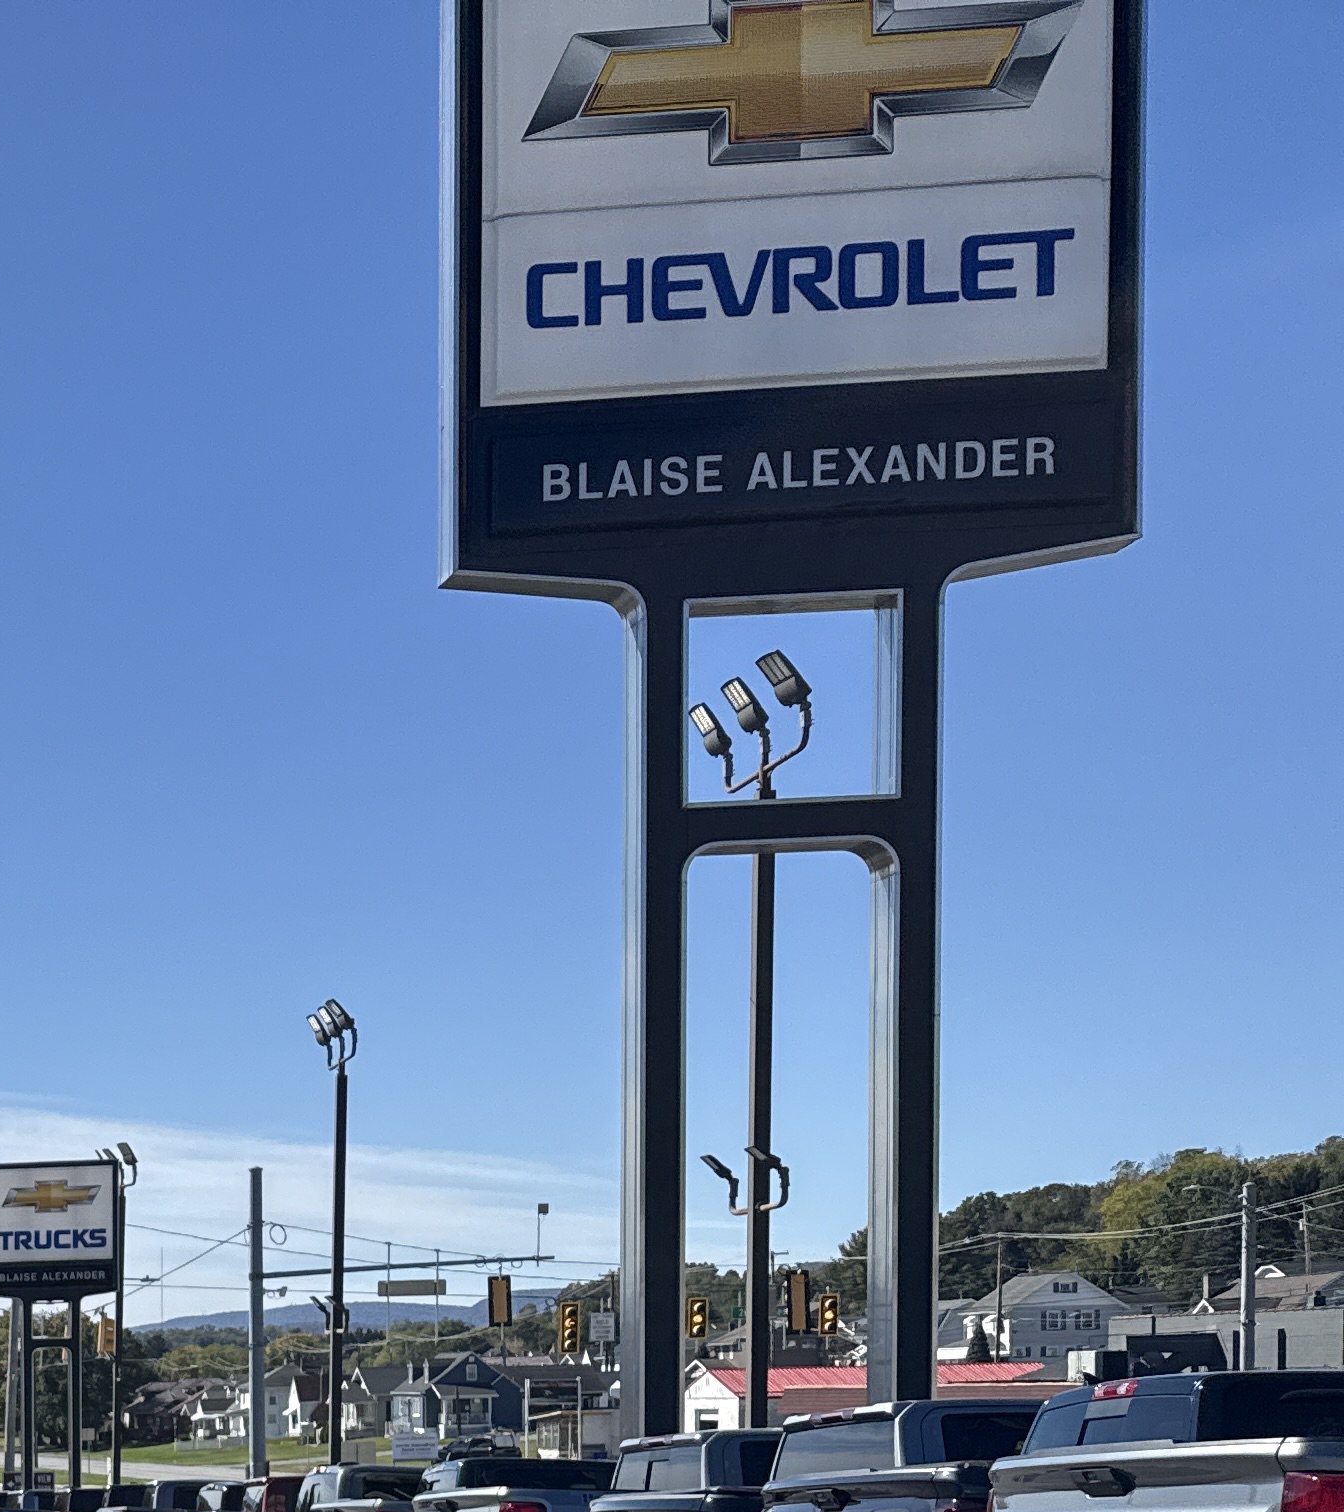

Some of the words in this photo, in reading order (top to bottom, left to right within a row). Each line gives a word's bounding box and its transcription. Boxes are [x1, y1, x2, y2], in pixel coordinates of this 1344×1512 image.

[525, 227, 1075, 330] CHEVROLET
[541, 453, 724, 503] BLAISE
[746, 436, 1056, 491] ALEXANDER
[0, 1271, 38, 1283] BLAISE
[41, 1270, 106, 1282] ALEXANDER
